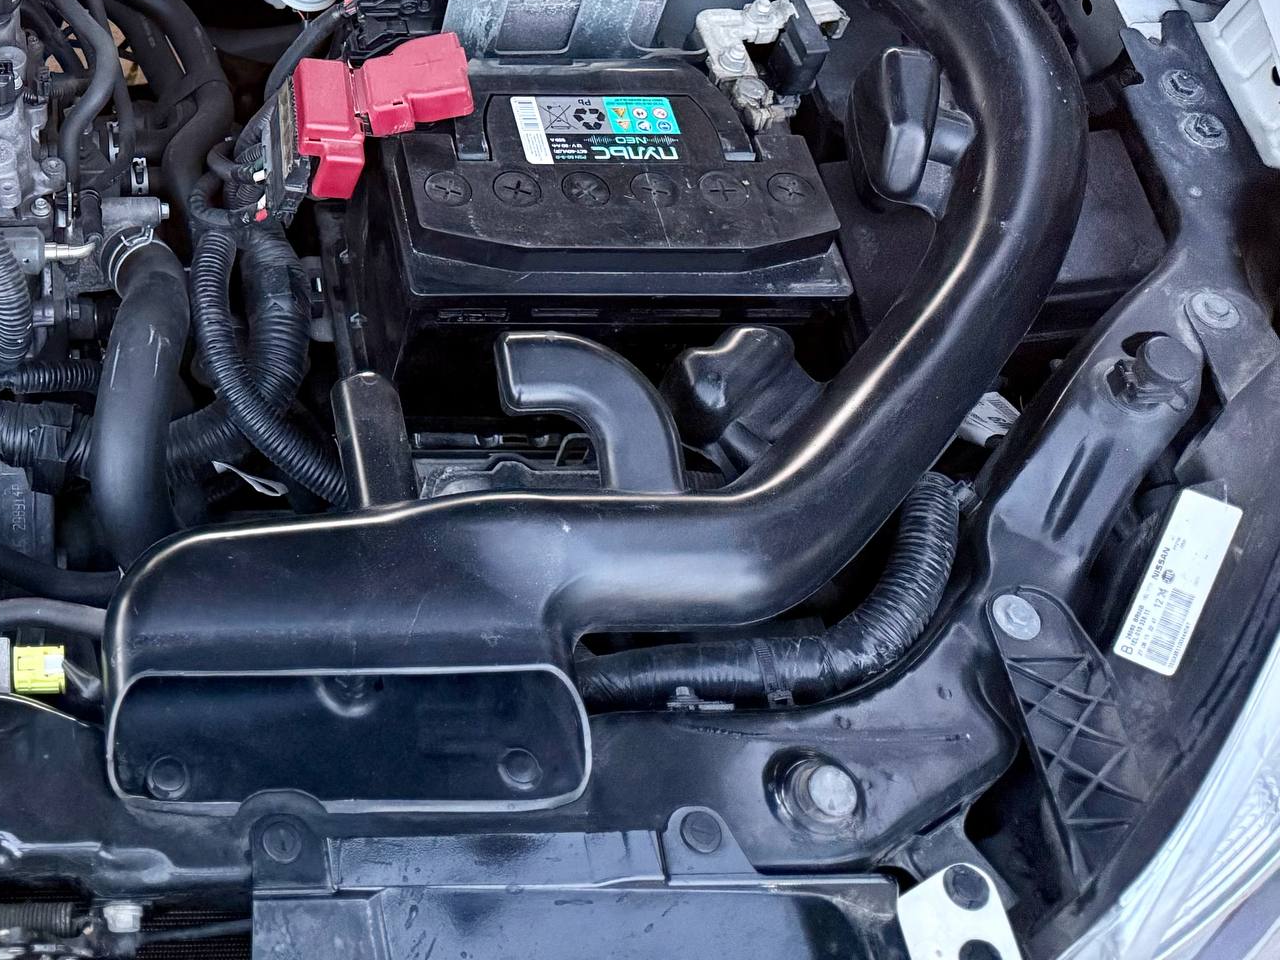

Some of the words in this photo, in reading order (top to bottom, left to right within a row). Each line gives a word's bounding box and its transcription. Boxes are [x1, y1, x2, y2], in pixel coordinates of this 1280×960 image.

[615, 136, 649, 144] NEO
[590, 146, 679, 160] ПУЛЬС
[1152, 547, 1170, 580] NISSAN
[1121, 645, 1133, 655] B
